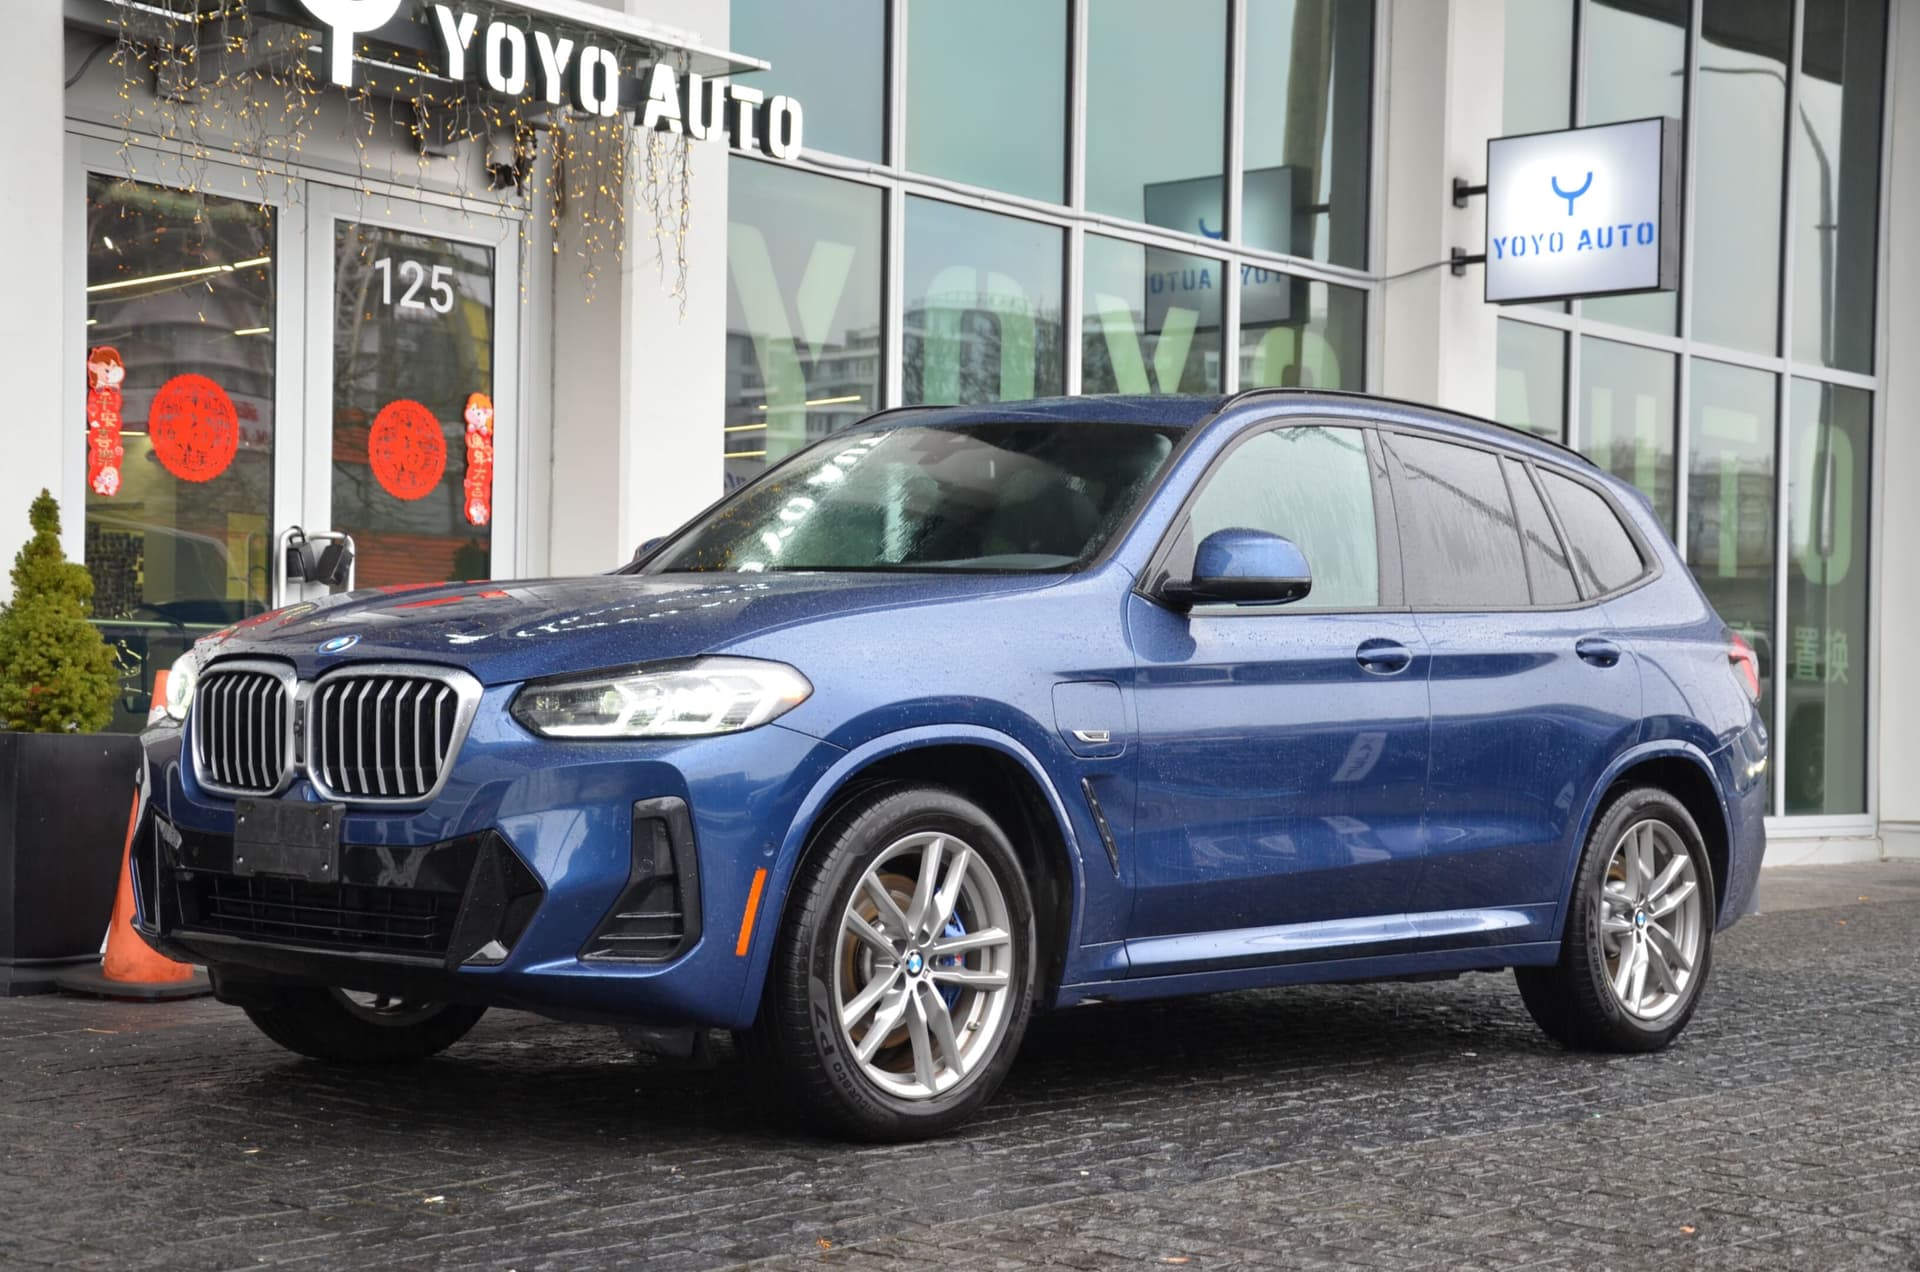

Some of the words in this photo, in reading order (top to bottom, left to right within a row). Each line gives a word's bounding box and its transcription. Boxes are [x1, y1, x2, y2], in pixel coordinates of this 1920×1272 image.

[435, 4, 620, 117] YOYO
[643, 63, 803, 160] AUTO
[1493, 231, 1564, 260] YOYO
[1576, 222, 1654, 251] AUTO
[375, 257, 454, 314] 125
